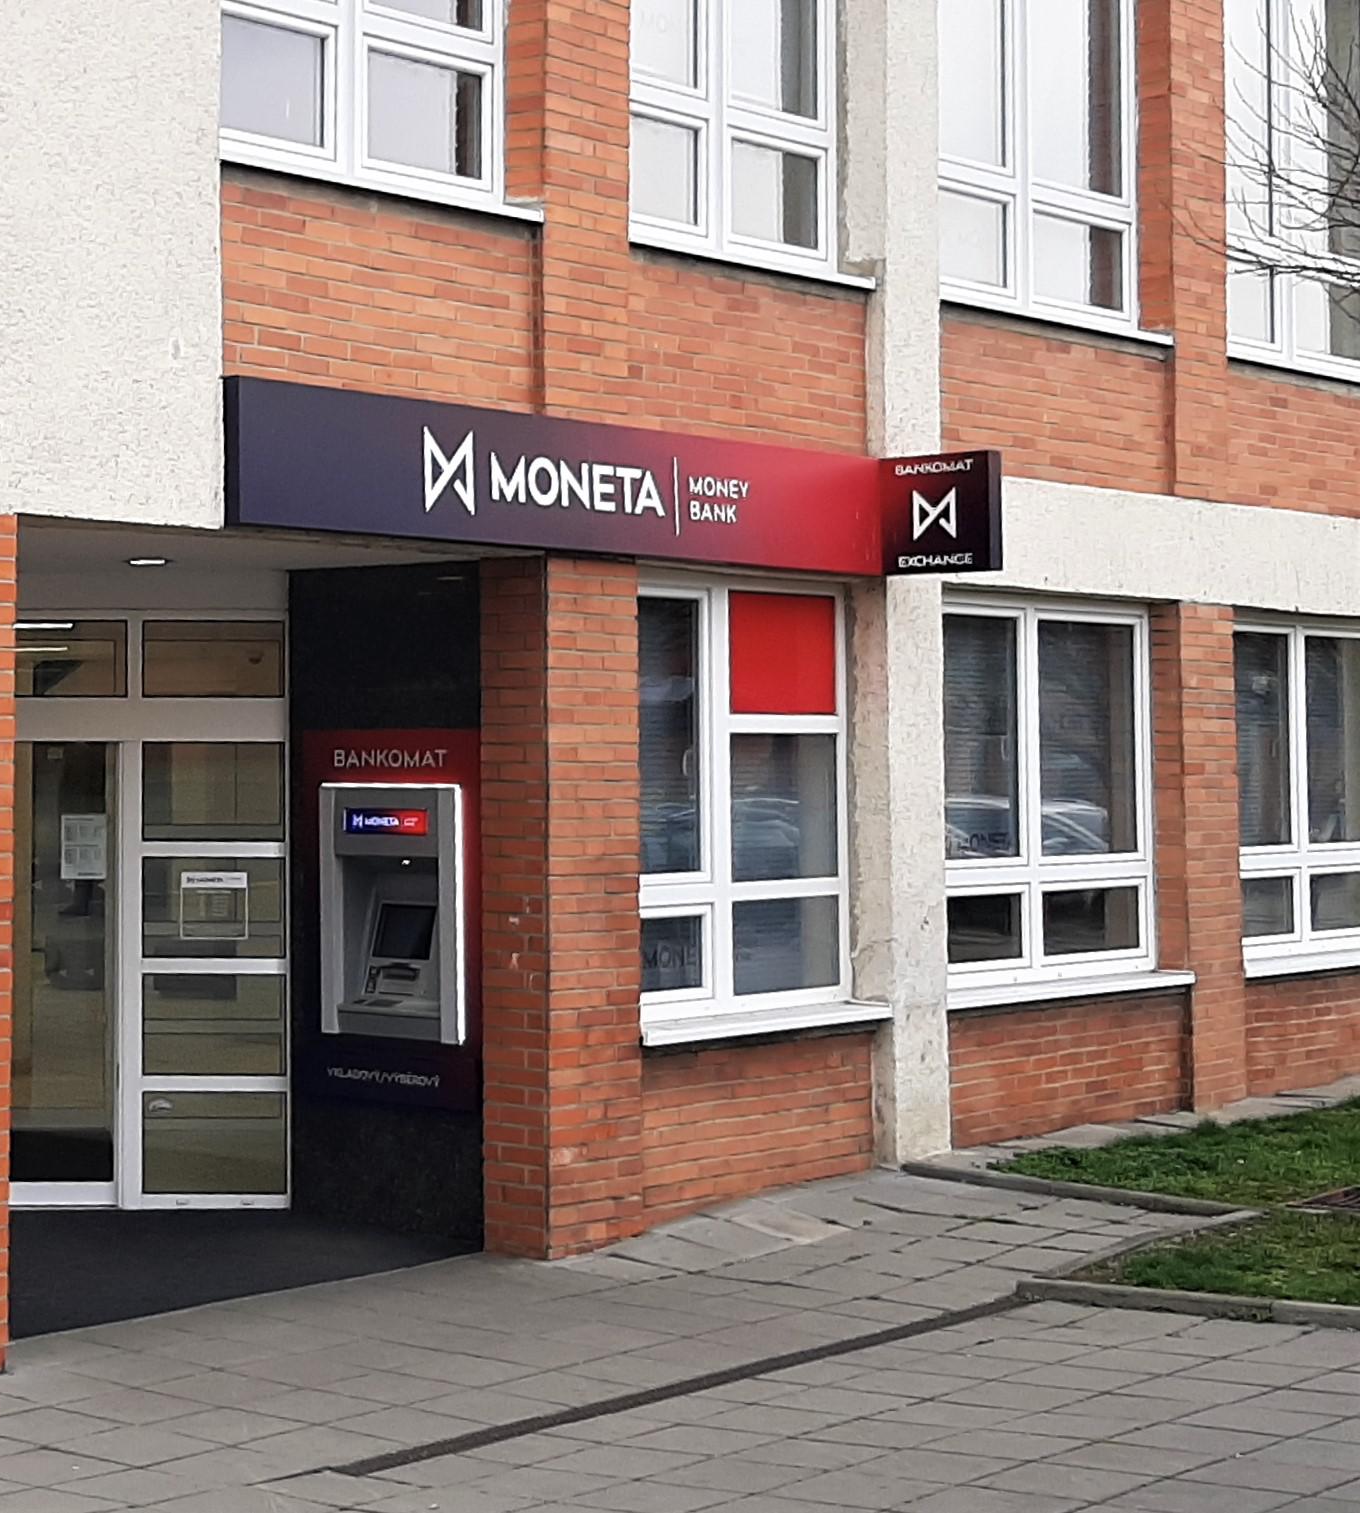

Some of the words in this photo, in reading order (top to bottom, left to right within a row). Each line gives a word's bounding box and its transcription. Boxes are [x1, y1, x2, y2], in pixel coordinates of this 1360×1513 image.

[895, 458, 974, 476] BANKOMAT
[490, 451, 666, 517] MONETA
[688, 475, 750, 500] MONEY
[689, 500, 737, 524] BANK
[897, 552, 974, 568] EXCHANGE
[333, 749, 448, 769] BANKOMAT
